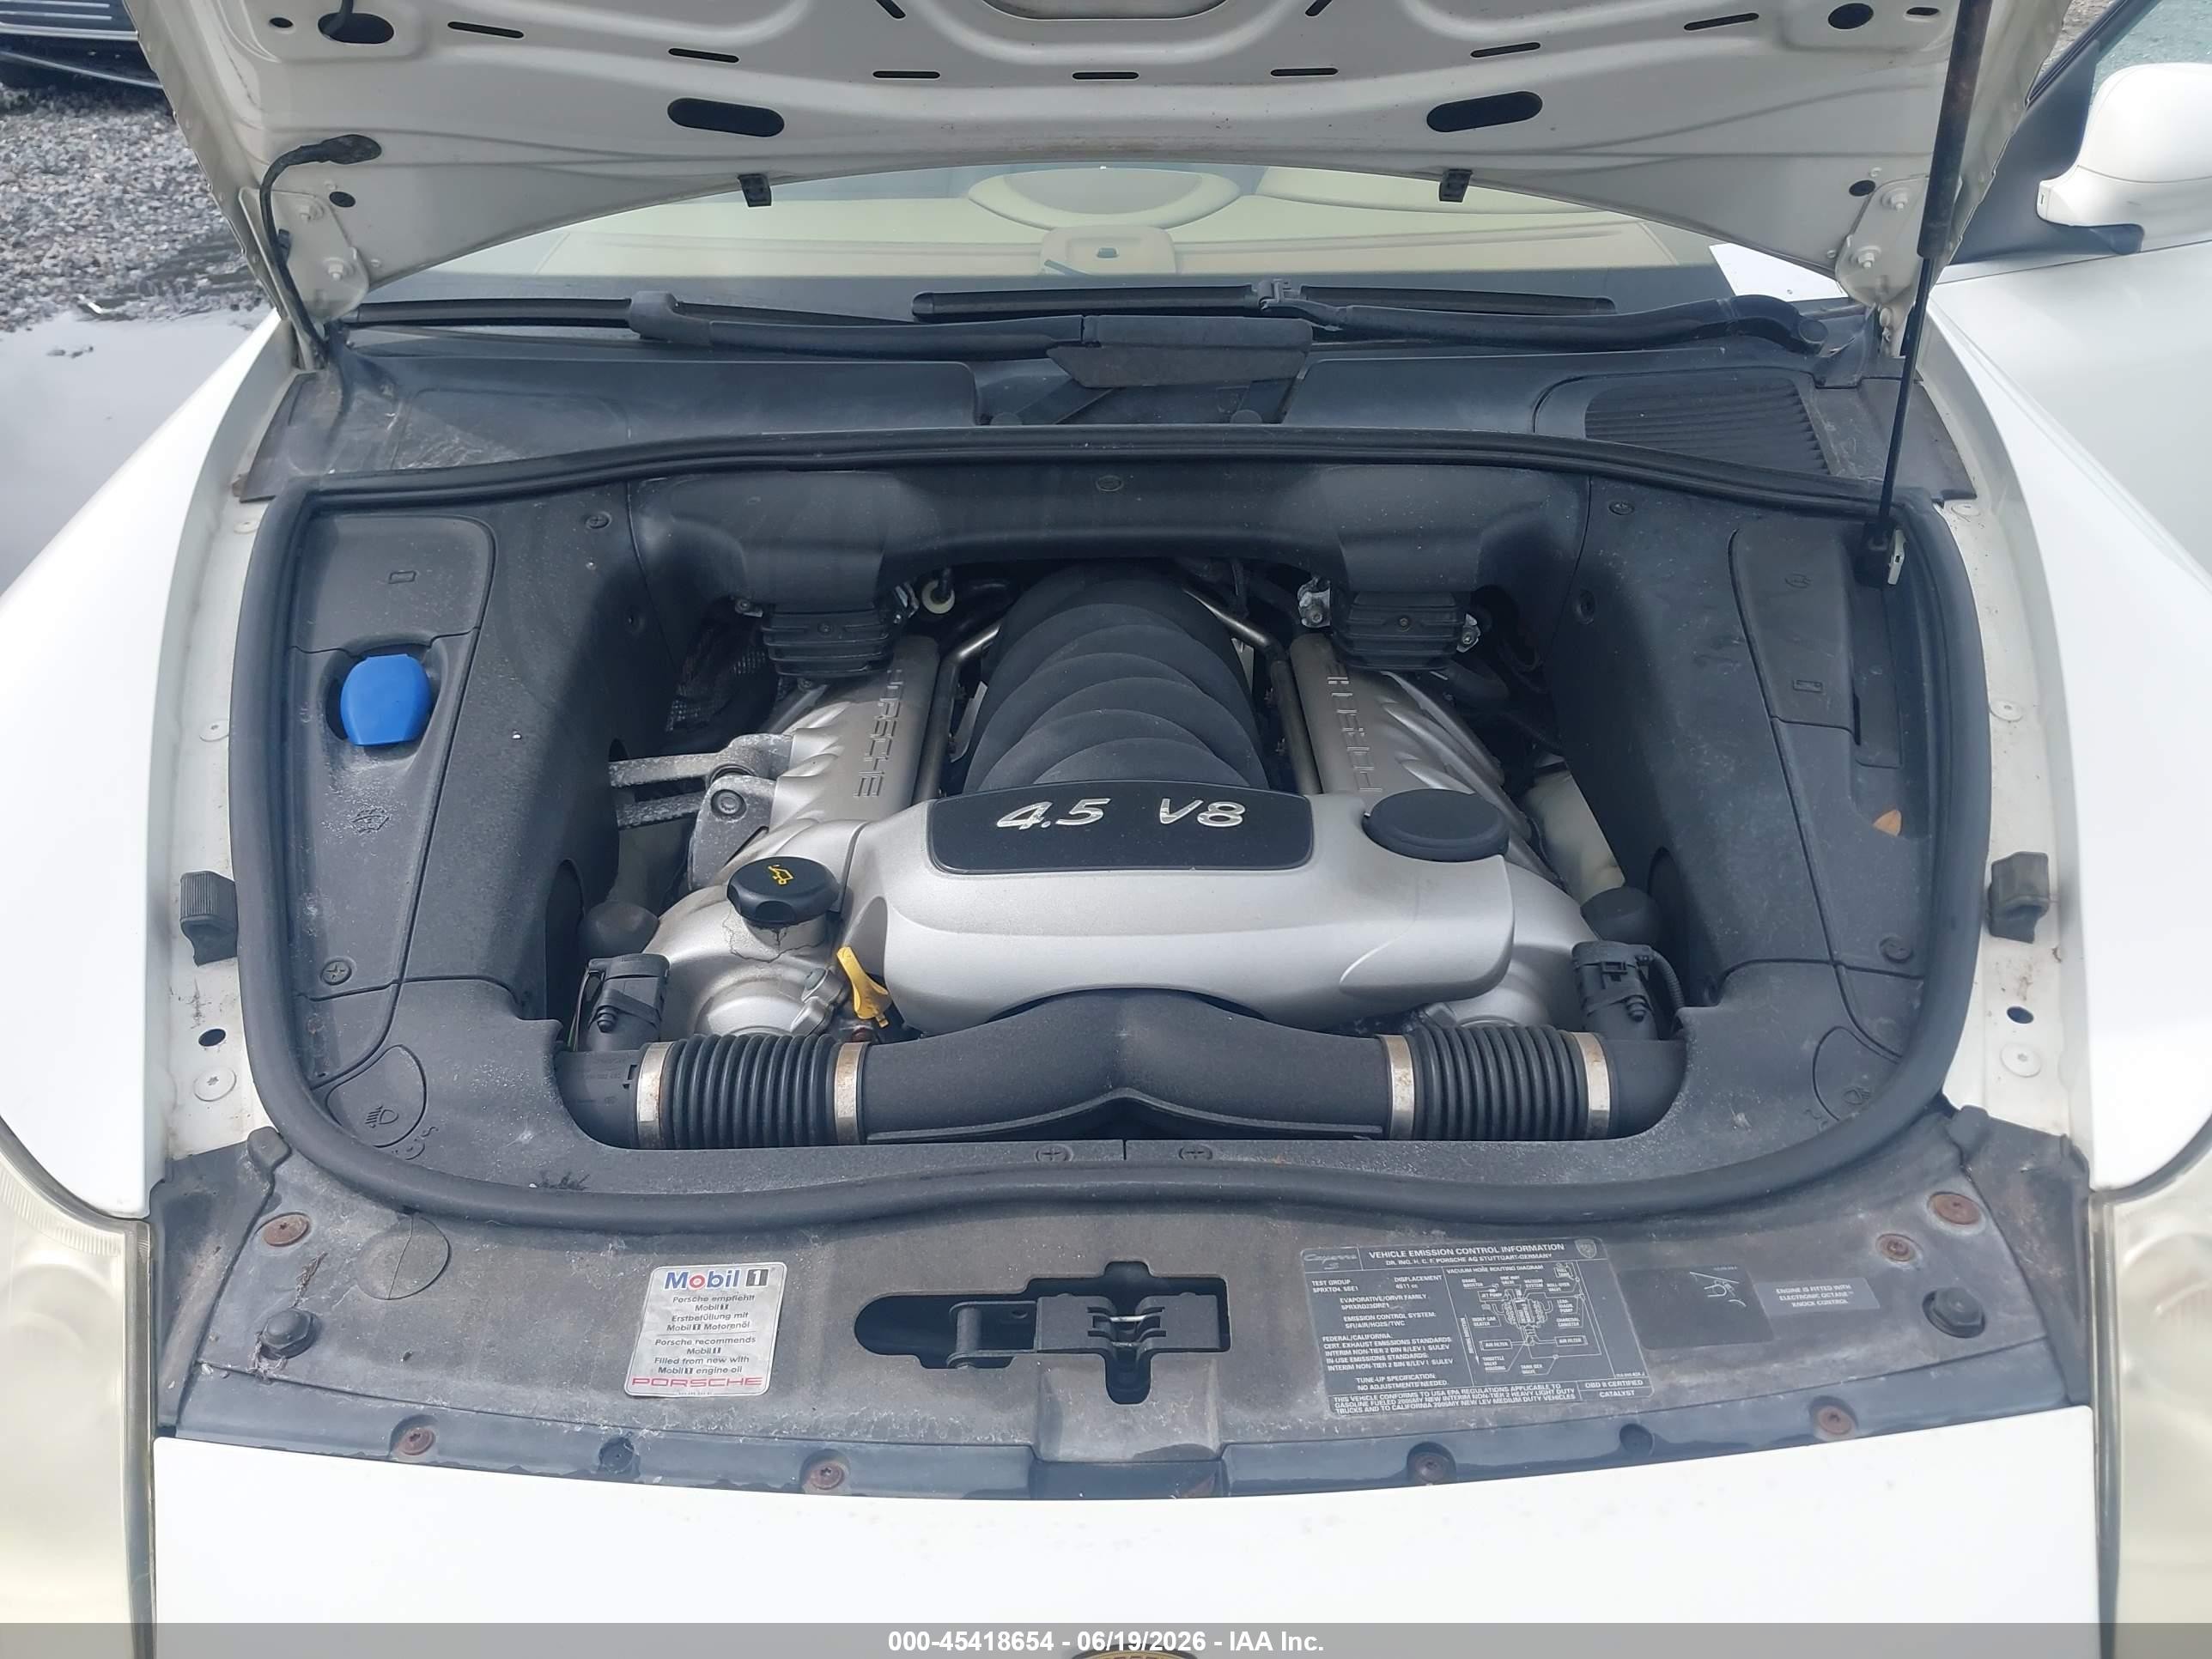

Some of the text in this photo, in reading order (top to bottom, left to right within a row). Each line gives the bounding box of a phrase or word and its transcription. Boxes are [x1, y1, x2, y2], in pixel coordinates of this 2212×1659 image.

[995, 798, 1246, 830] 4.5 V8
[1369, 1243, 1565, 1259] VEHICLE EMISSION CONTROL INFORMATION
[665, 1269, 740, 1289] Mobil
[695, 1336, 756, 1345] recommends
[632, 1377, 763, 1387] PORSCHE
[1392, 1402, 1433, 1410] CALIFORNIA
[1544, 1393, 1576, 1401] VEHICLES
[1599, 1390, 1635, 1398] CATALYST
